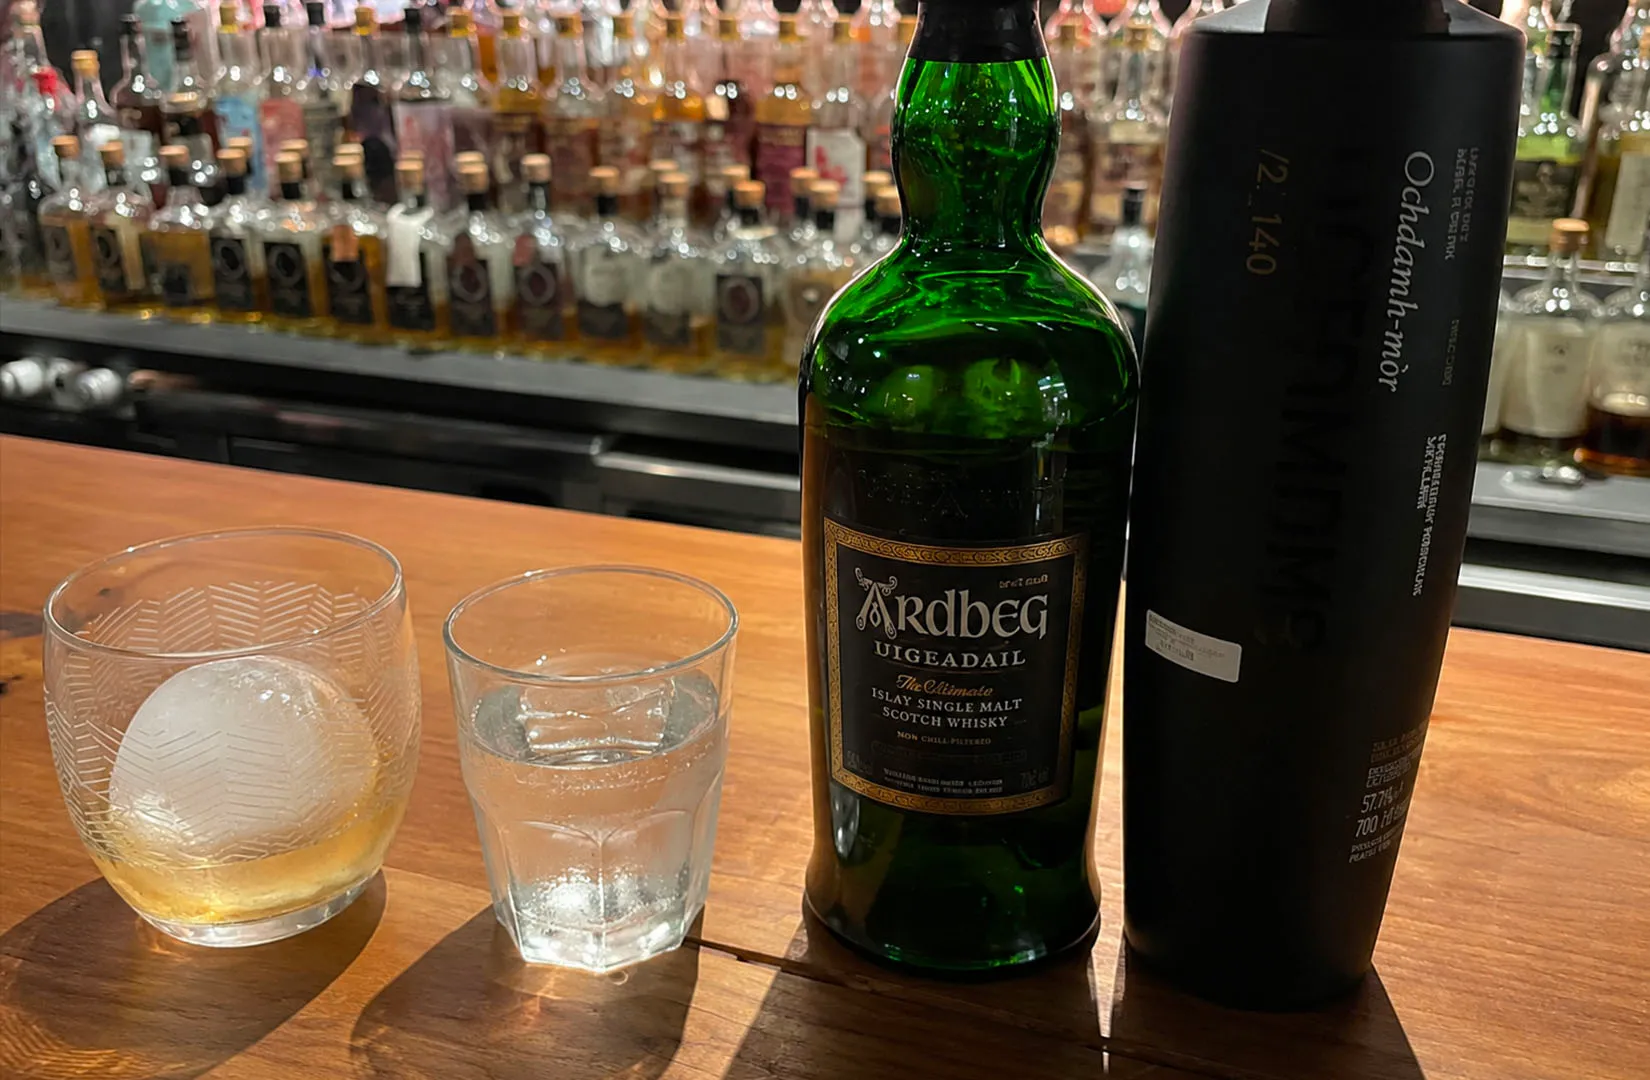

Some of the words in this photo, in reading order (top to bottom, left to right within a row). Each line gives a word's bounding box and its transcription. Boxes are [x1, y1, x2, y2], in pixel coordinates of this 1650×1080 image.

[1378, 150, 1435, 393] Ochdamh-mòr
[854, 566, 1049, 640] Ardbeg
[873, 640, 1026, 669] UIGEADAIL
[895, 674, 922, 692] The
[871, 687, 912, 707] ISLAY
[917, 697, 974, 713] SINGLE
[979, 698, 1023, 714] MALT
[882, 706, 942, 728] SCOTCH
[947, 716, 1009, 729] WHISKY
[1355, 814, 1379, 838] 700
